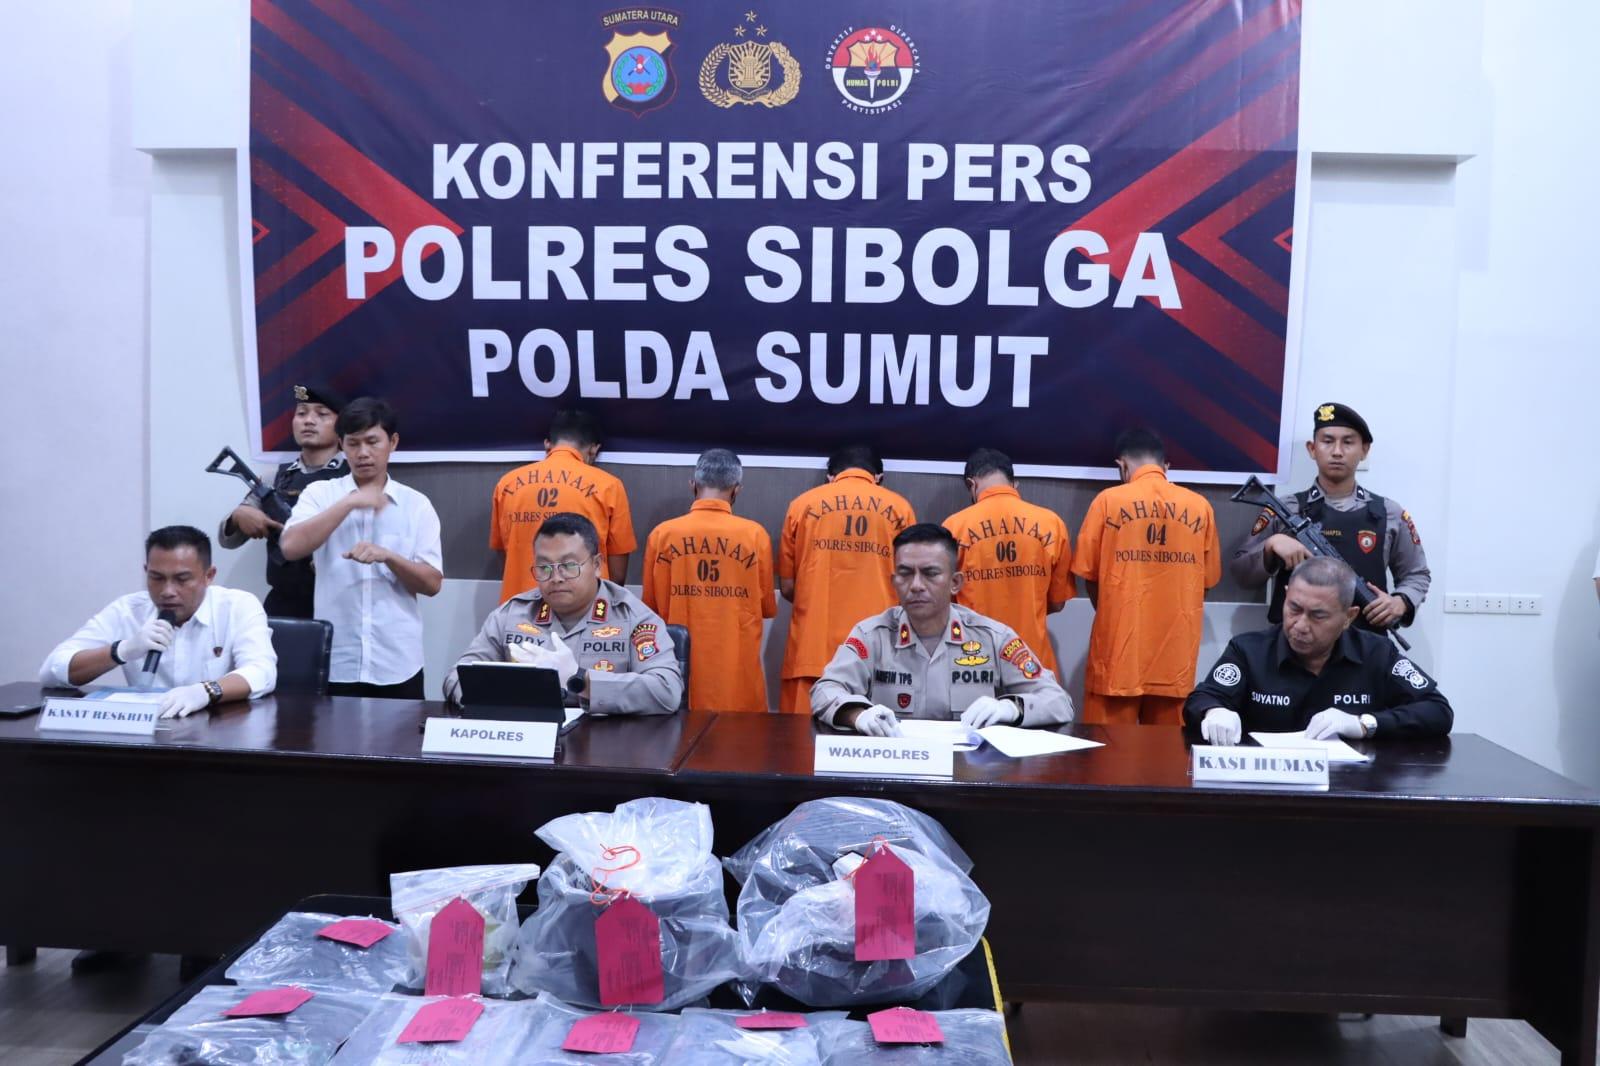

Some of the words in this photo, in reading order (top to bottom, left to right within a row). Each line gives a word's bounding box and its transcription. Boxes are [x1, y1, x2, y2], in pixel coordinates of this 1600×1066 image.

[603, 10, 649, 26] SUMATERA
[651, 11, 678, 25] UTARA
[890, 24, 920, 74] DIPERCAYA
[846, 79, 868, 87] HUMAS
[876, 79, 899, 87] POLRI
[841, 99, 902, 114] PARTISIPASI
[433, 141, 878, 201] KONFERENSI
[907, 142, 1092, 204] PERS
[345, 224, 710, 302] POLRES
[744, 225, 1183, 310] SIBOLGA
[468, 328, 729, 401] POLDA
[754, 331, 1049, 408] SUMUT
[501, 469, 598, 498] TAHANAN
[537, 487, 558, 508] 02
[808, 494, 906, 530] TAHANAN
[1105, 500, 1205, 534] TAHANAN
[844, 514, 868, 537] 10
[957, 516, 1055, 551] TAHANAN
[1146, 522, 1167, 546] 04
[656, 536, 758, 570] TAHANAN
[812, 539, 852, 551] POLRES
[995, 540, 1017, 563] 06
[1153, 550, 1196, 563] SIBOLGA
[697, 559, 720, 582] 05
[966, 566, 1004, 581] POLRES
[1005, 564, 1047, 578] SIBOLGA
[670, 584, 702, 597] OLRES
[704, 585, 749, 599] SIBOLGA
[583, 641, 625, 652] POLRI
[951, 670, 994, 684] POLRI
[1251, 691, 1291, 706] SUYATNO
[1333, 694, 1371, 705] POLRI
[47, 708, 89, 719] KASAT
[92, 710, 154, 722] RESKRIM
[450, 727, 524, 742] KAPOLRES
[828, 746, 930, 761] WAKAPOLRES
[1199, 756, 1247, 770] KASI
[1254, 757, 1326, 773] HUMAS
